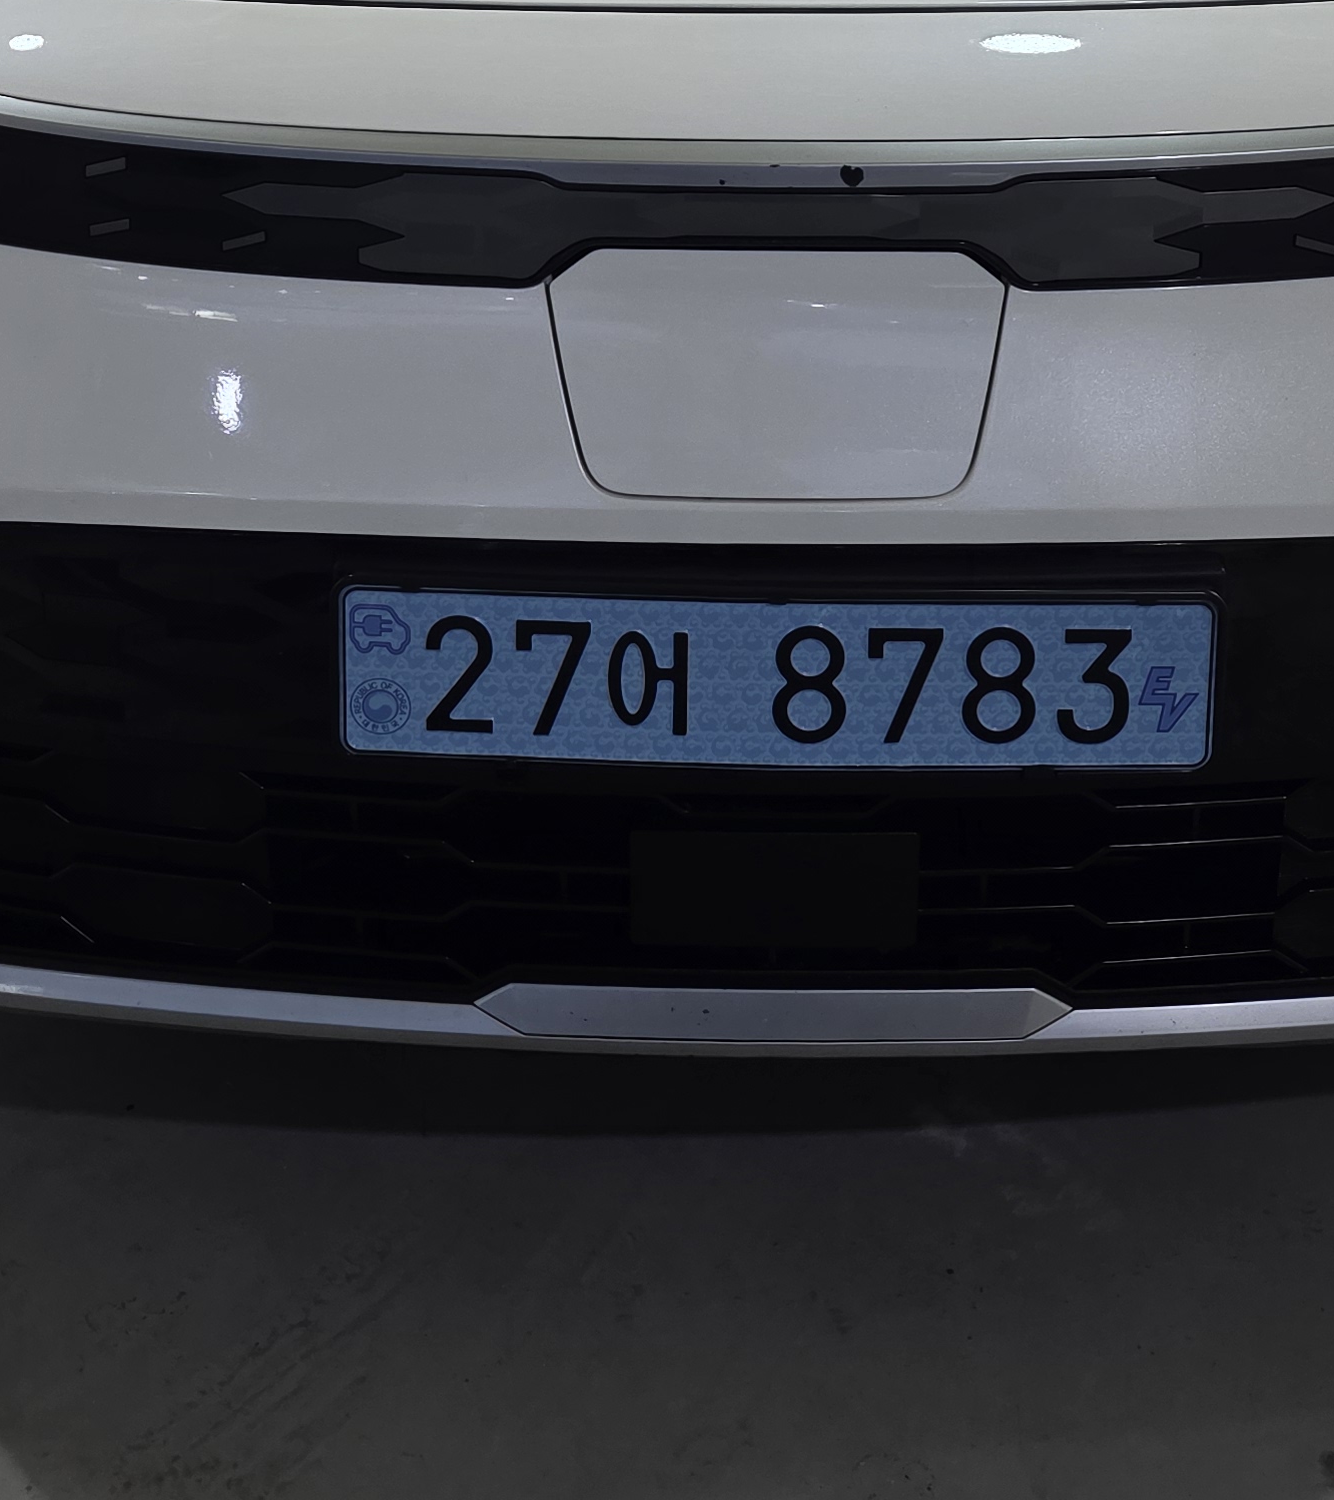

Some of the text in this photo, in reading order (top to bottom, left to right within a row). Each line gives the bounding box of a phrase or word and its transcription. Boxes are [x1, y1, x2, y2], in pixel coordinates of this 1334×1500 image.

[353, 681, 408, 716] REPUBLIC OF KOREA
[424, 614, 1133, 746] 27어 8783
[1138, 666, 1200, 733] EV
